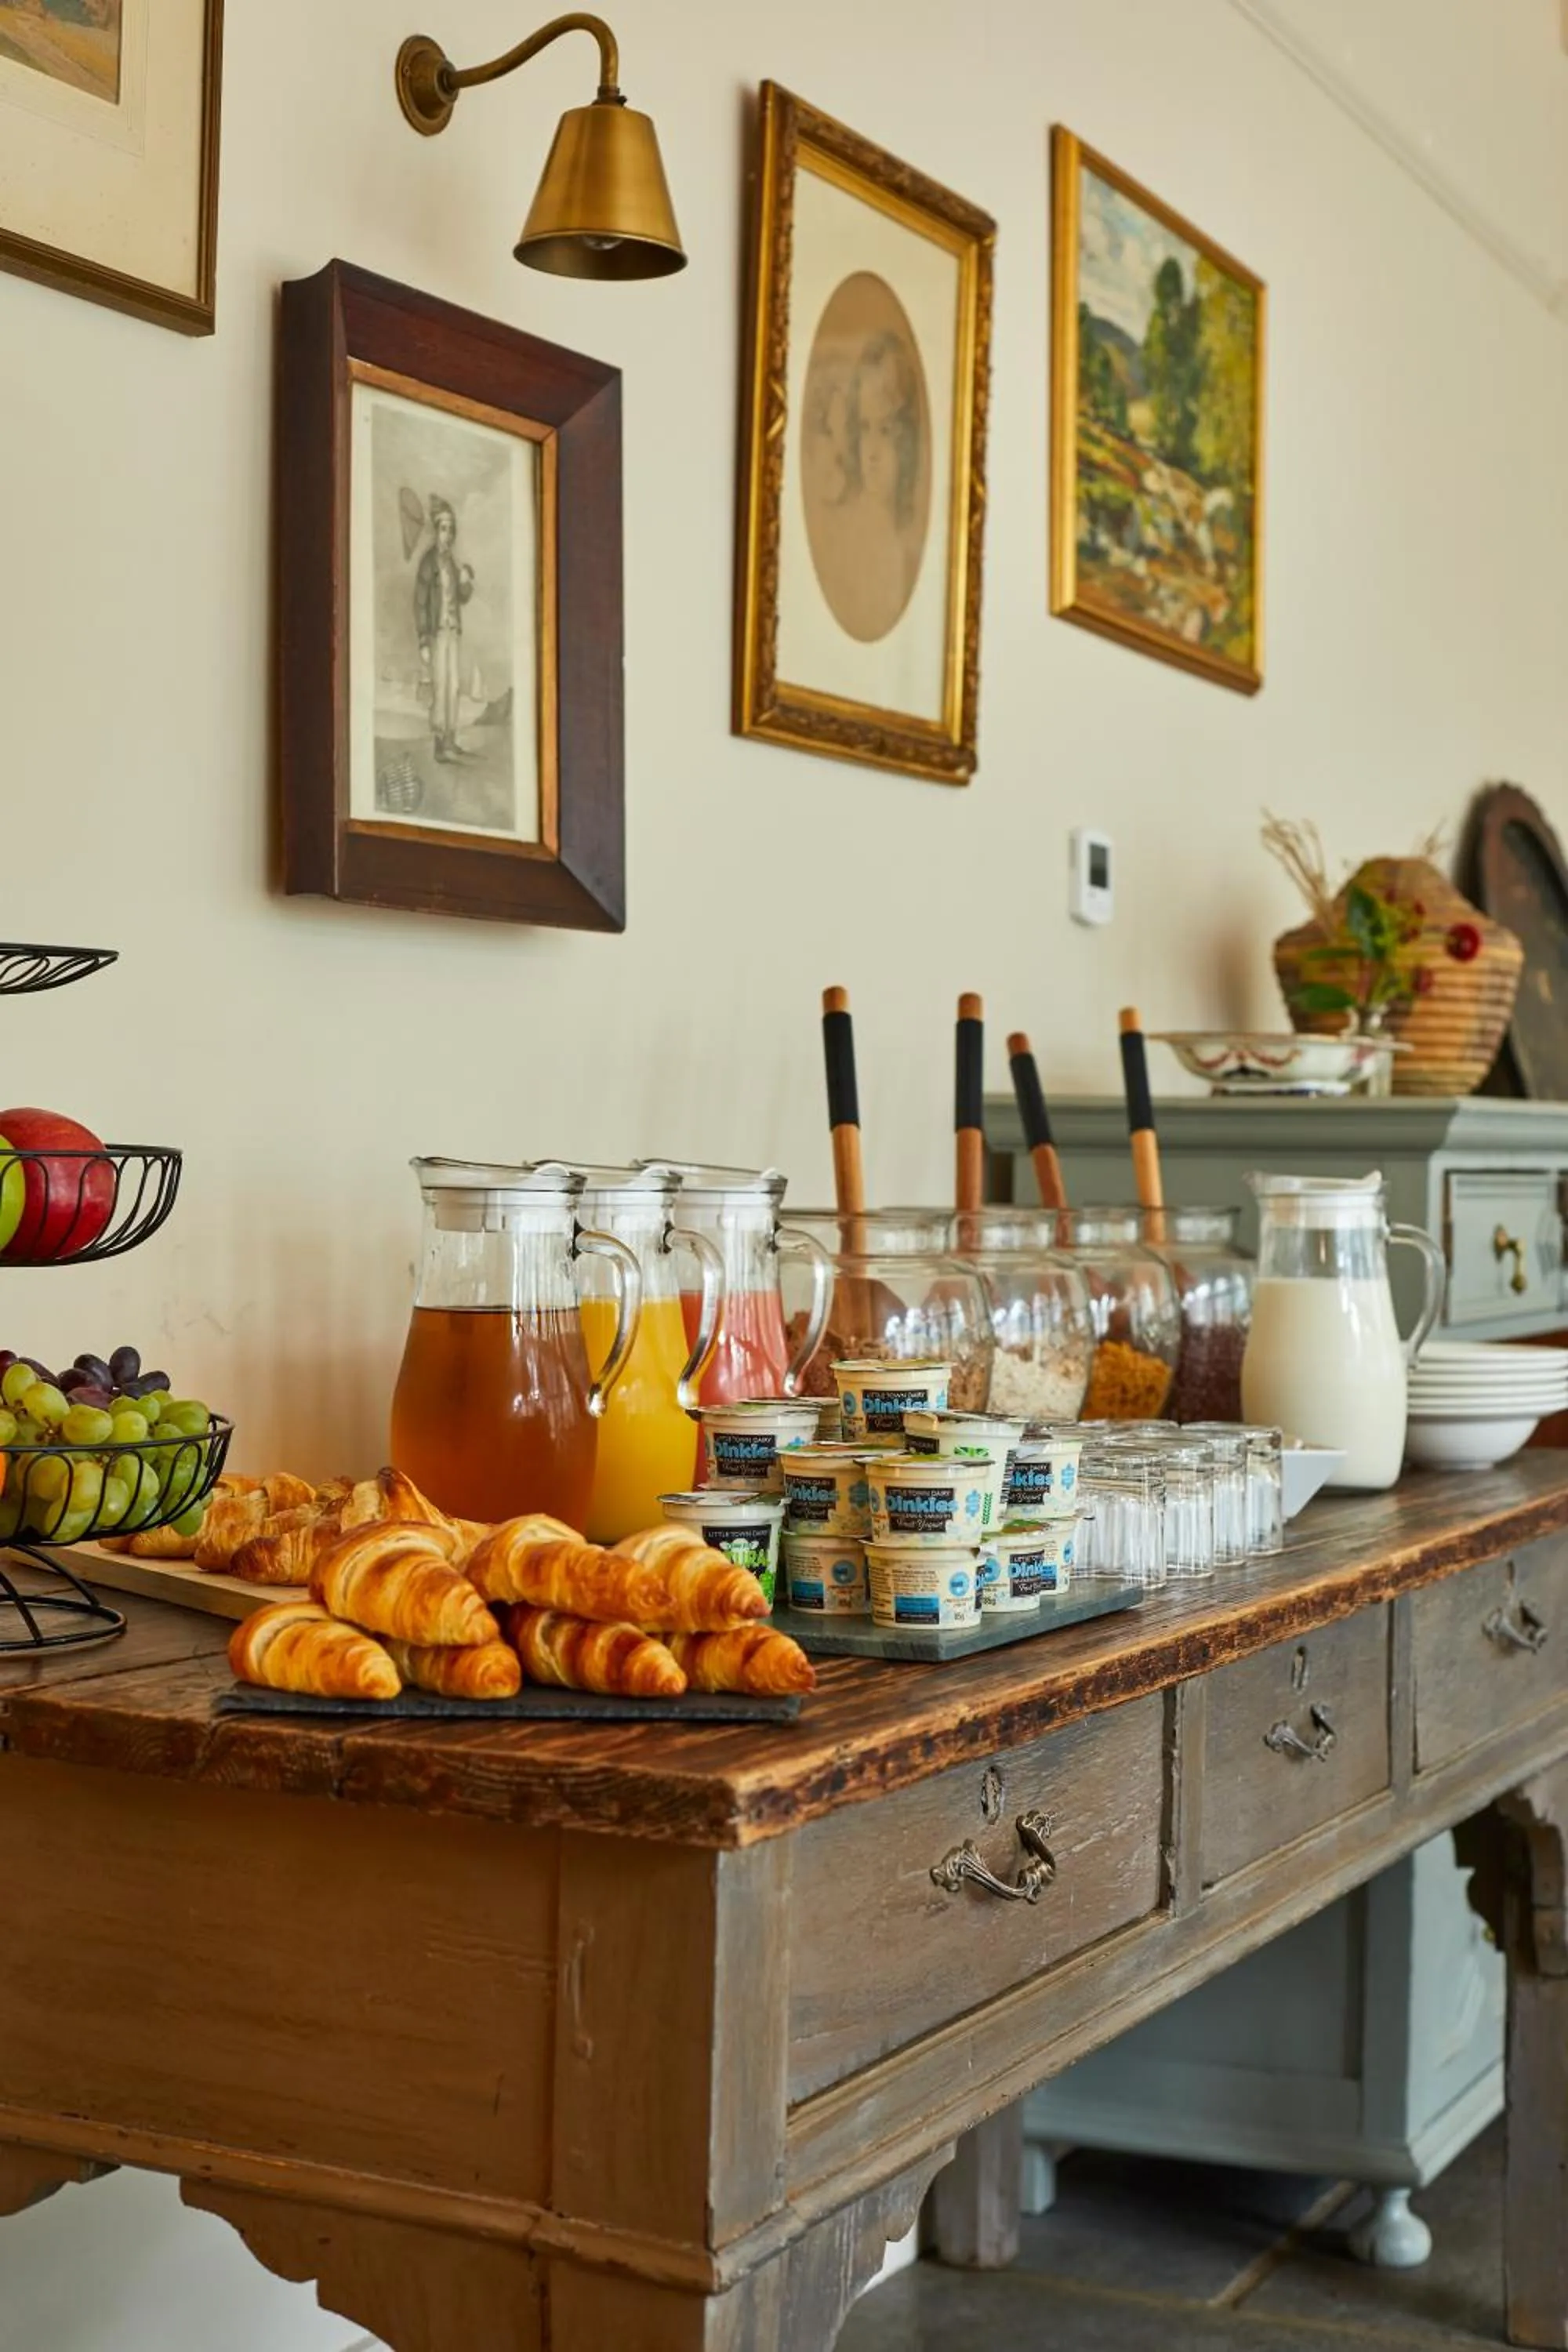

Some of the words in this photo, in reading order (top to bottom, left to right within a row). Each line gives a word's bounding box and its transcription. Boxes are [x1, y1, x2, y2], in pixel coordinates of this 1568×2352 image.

[862, 1397, 931, 1414] Dinkies
[1010, 1470, 1054, 1487] kies
[785, 1484, 839, 1501] inkies
[887, 1494, 959, 1513] Dinkies
[1007, 1560, 1044, 1579] Dink
